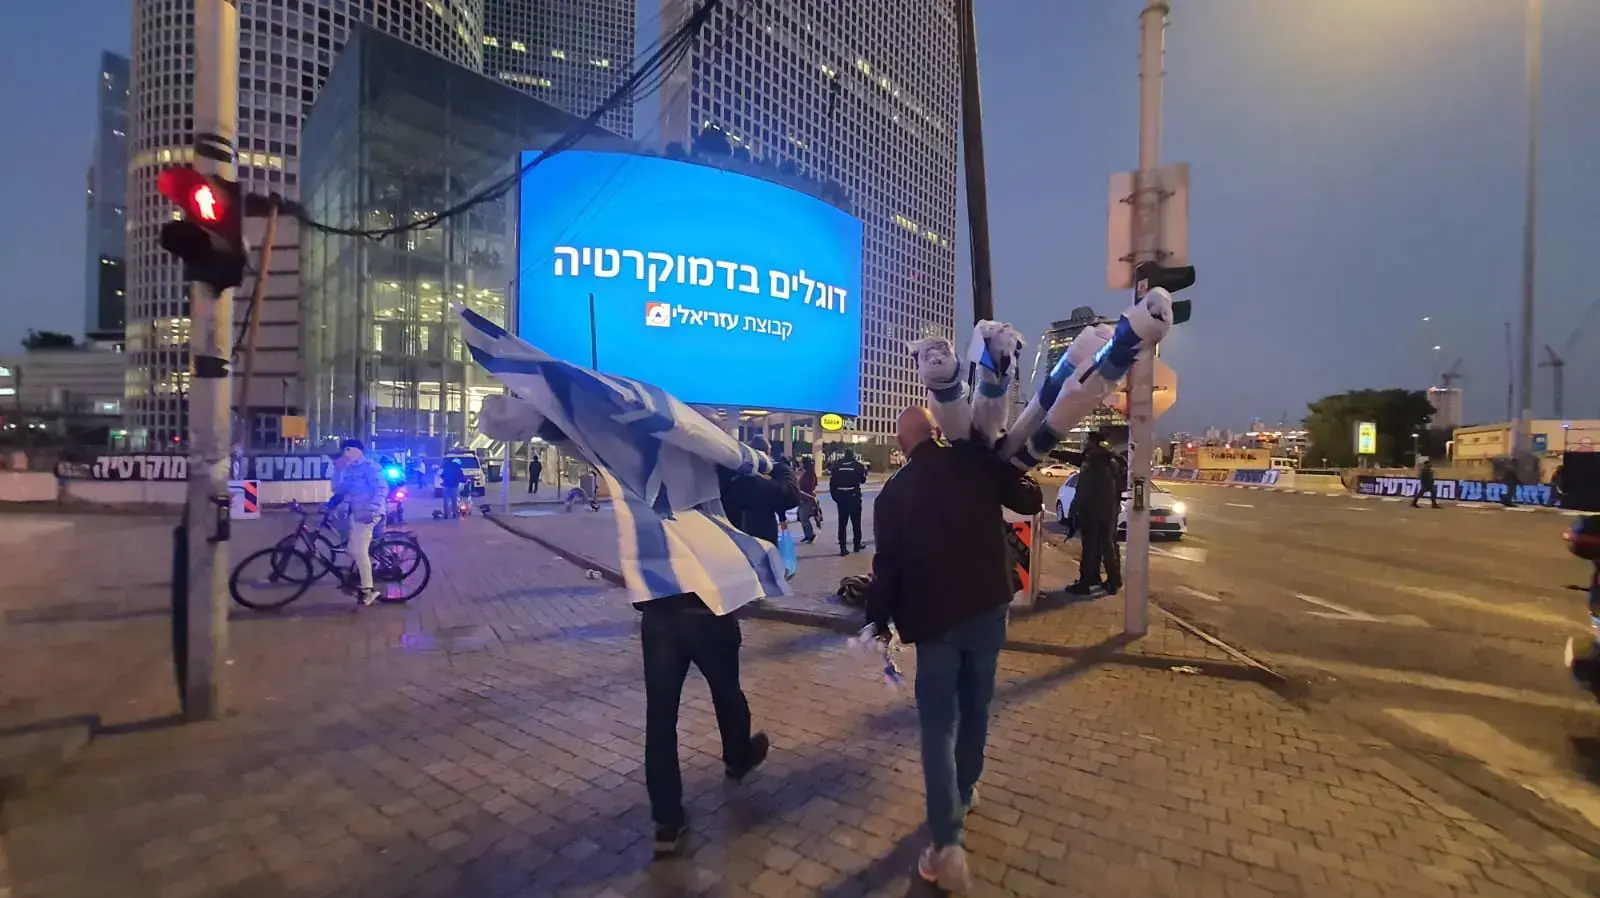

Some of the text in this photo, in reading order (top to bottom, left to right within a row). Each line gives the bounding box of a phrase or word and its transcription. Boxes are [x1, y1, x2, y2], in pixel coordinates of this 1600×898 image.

[554, 246, 847, 314] דוגלים בדמוקרטיה
[672, 305, 793, 341] קבוצת עזריאלי
[92, 455, 188, 479] מוקרטיה
[255, 455, 335, 479] לחמים
[1375, 477, 1456, 499] הדוקרטיה
[1458, 479, 1482, 500] על
